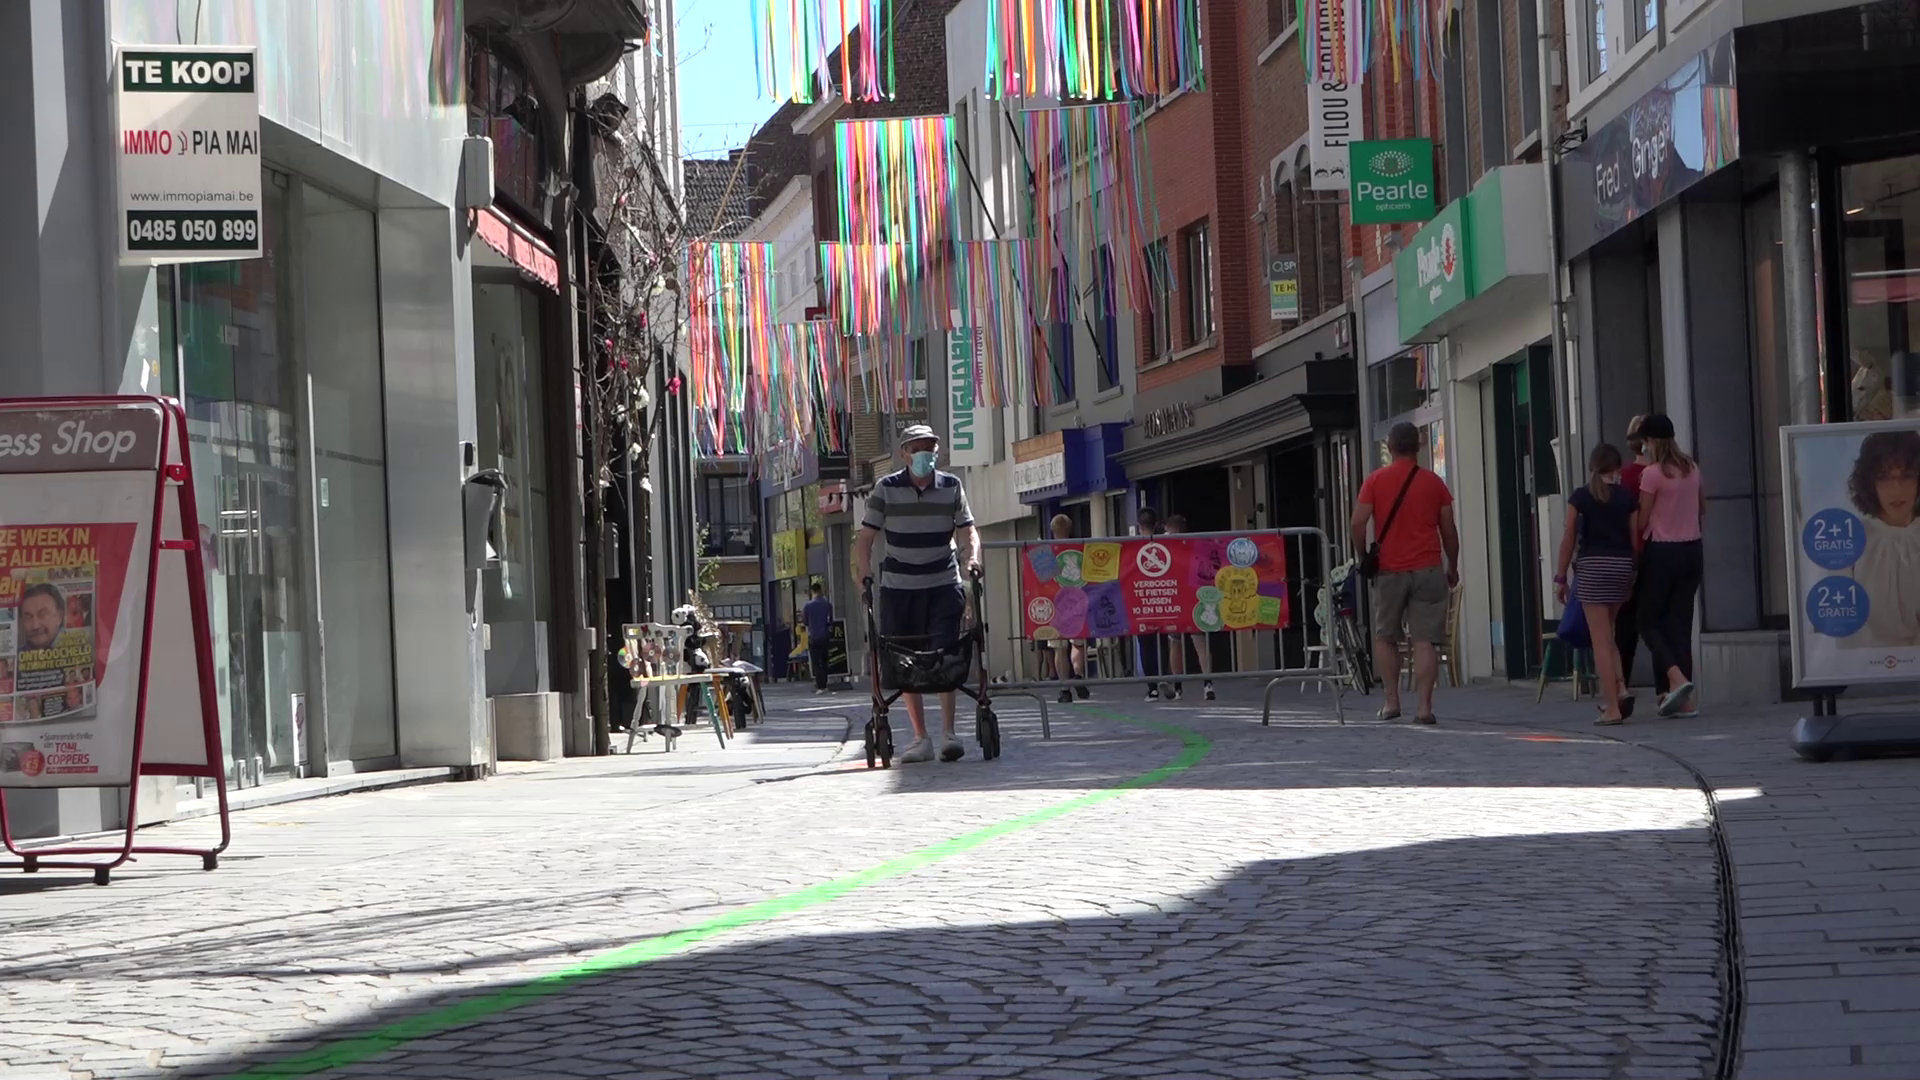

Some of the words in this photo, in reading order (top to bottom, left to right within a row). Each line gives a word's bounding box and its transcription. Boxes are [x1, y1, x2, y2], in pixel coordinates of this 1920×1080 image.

[125, 60, 162, 84] TE
[171, 61, 250, 84] KOOP
[1322, 79, 1348, 92] &
[1323, 98, 1349, 147] FILOU
[124, 130, 172, 155] IMMO
[193, 130, 221, 155] PIA
[226, 130, 257, 155] MAI
[1596, 151, 1620, 203] Fred
[131, 191, 254, 204] www.immopiamai.be
[1357, 180, 1428, 201] Pearle
[1375, 203, 1411, 211] opticiens
[130, 219, 176, 242] 0485
[182, 219, 217, 242] 050
[222, 219, 256, 242] 899
[1275, 284, 1285, 292] TE
[52, 420, 137, 463] Shop
[1814, 518, 1853, 540] 2+1
[21, 528, 70, 546] WEEK
[72, 528, 90, 545] IN
[1814, 540, 1853, 551] GRATIS
[10, 547, 100, 568] ALLEMAAL
[1133, 580, 1177, 588] VERBODEN
[1134, 589, 1144, 597] TE
[1146, 588, 1177, 597] FIETSEN
[1817, 586, 1857, 607] 2+1
[1141, 597, 1171, 605] TUSSEN
[1132, 607, 1141, 615] 10
[1143, 606, 1153, 614] EN
[1155, 605, 1163, 613] 18
[1165, 605, 1181, 613] UUR
[1818, 607, 1857, 618] GRATIS
[47, 754, 90, 765] COPPERS
